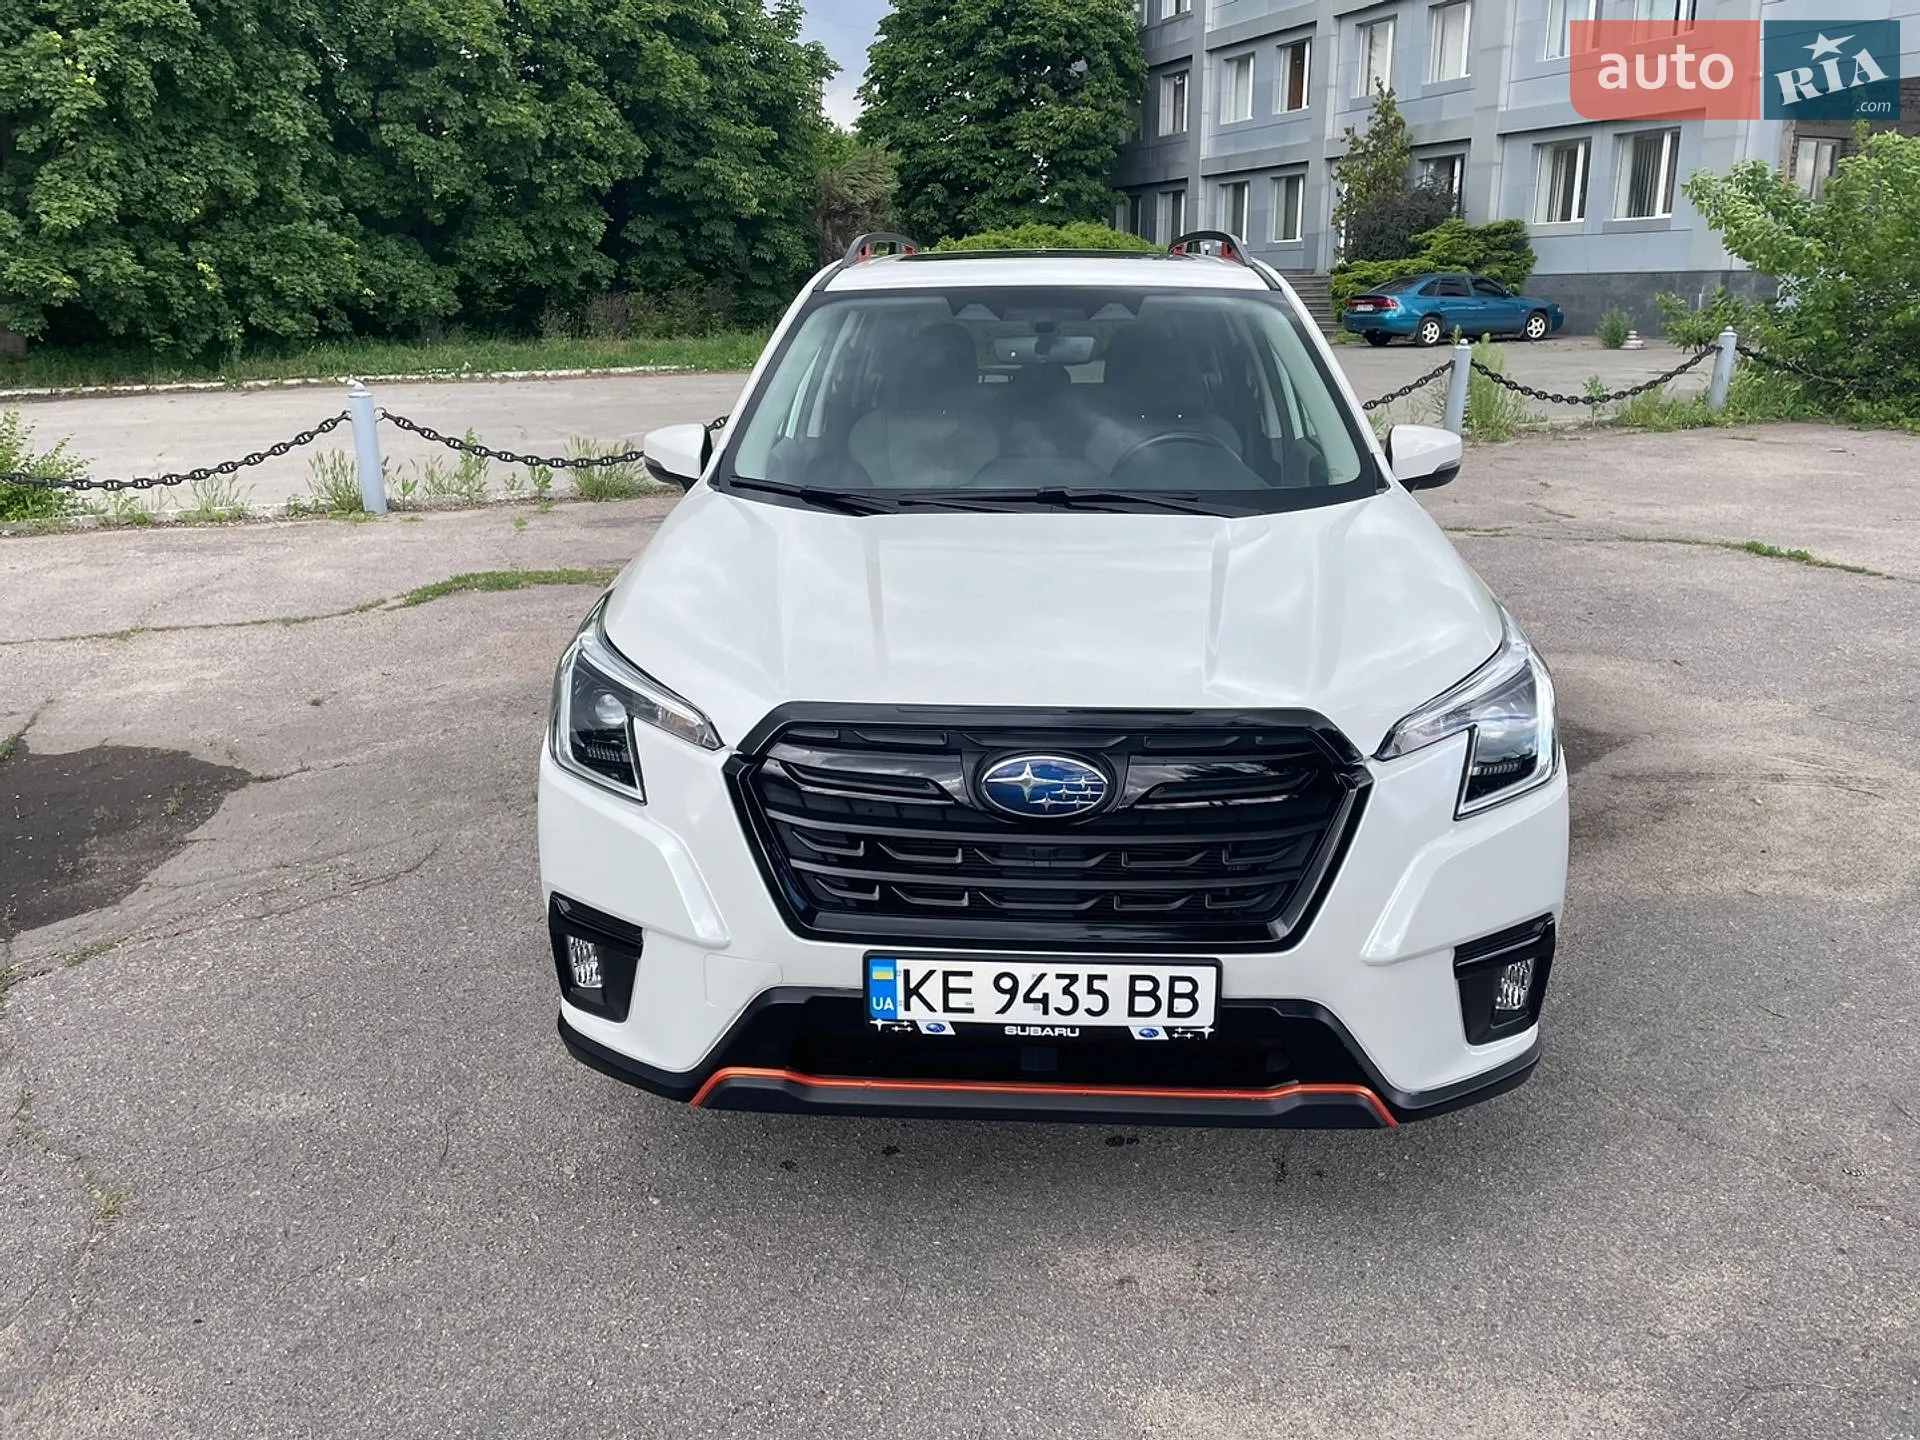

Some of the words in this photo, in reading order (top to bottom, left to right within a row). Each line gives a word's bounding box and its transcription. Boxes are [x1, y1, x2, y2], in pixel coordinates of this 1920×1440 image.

[903, 969, 974, 1014] KE
[993, 972, 1110, 1018] 9435
[1127, 974, 1200, 1019] BB
[873, 997, 895, 1011] UA
[1004, 1025, 1080, 1037] SUBARU
